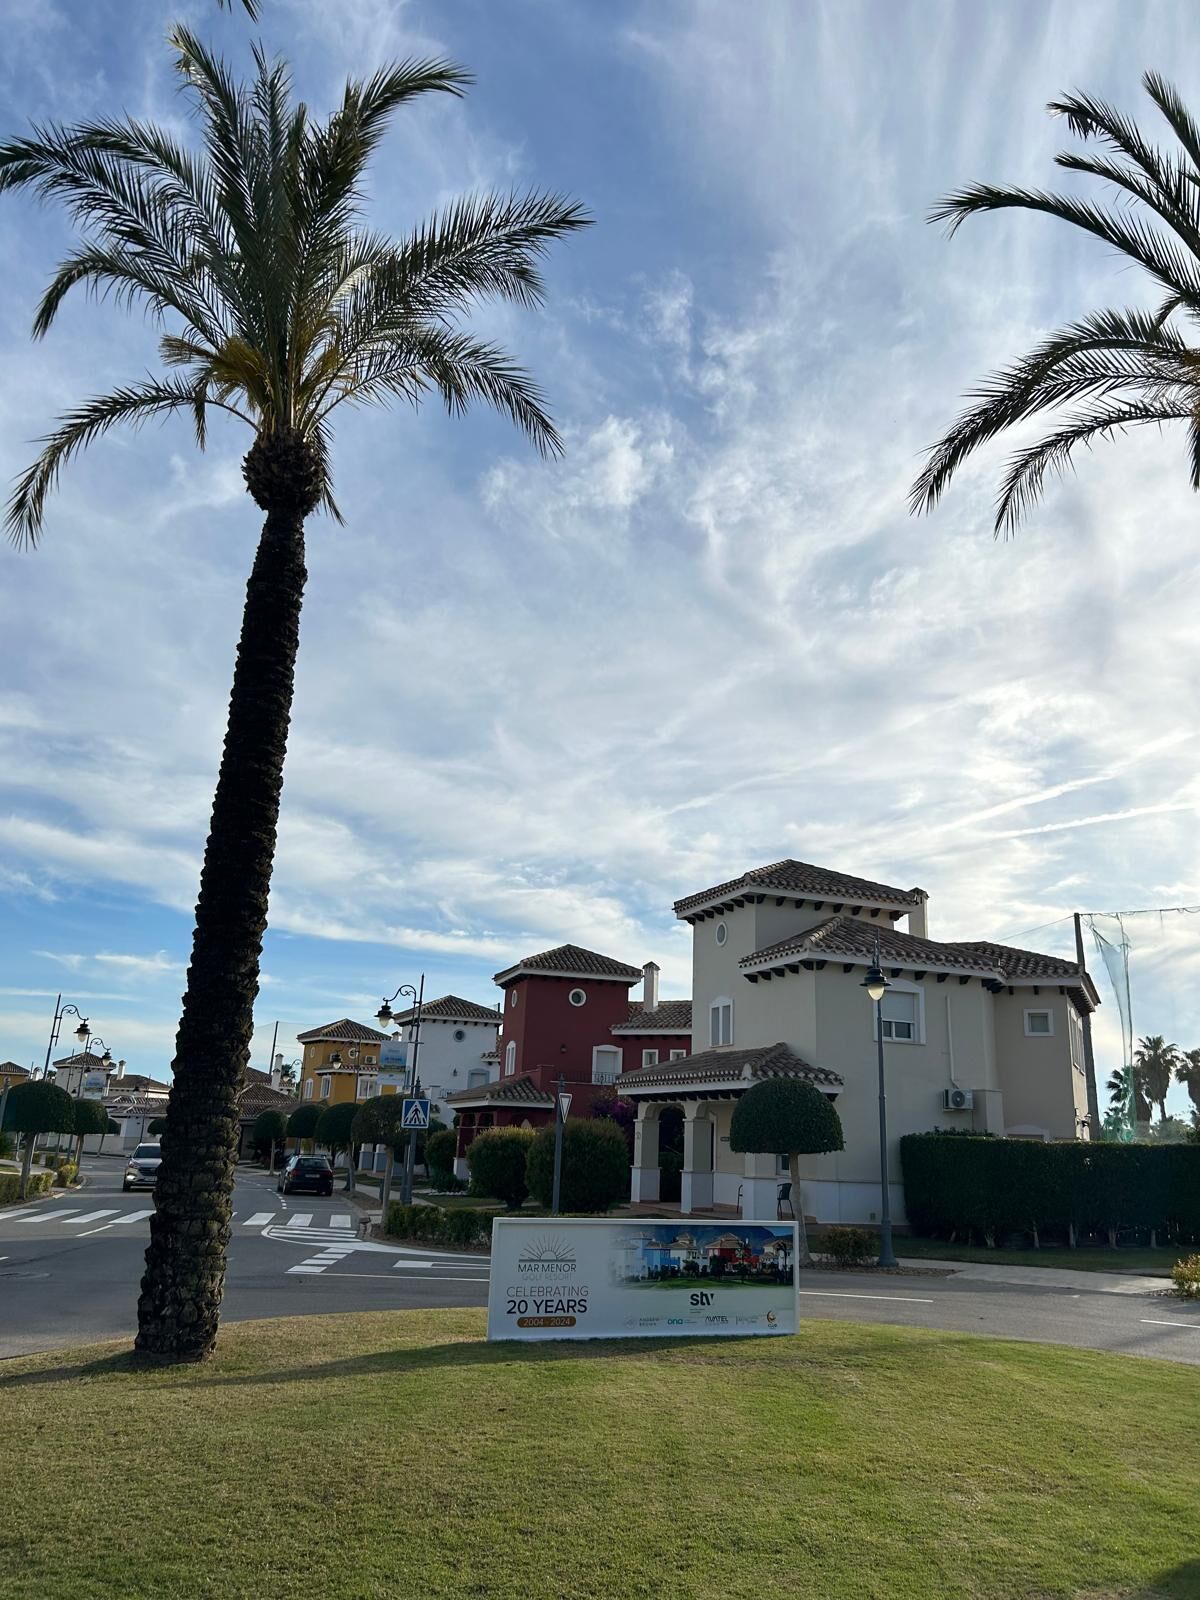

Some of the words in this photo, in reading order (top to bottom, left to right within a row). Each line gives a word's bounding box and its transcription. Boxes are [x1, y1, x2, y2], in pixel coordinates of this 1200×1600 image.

[518, 1263, 540, 1273] MAR
[541, 1263, 577, 1273] MENOR
[506, 1286, 589, 1298] CELEBRATING
[506, 1299, 528, 1314] 20
[533, 1299, 588, 1314] YEARS
[523, 1318, 544, 1326] 2004
[550, 1317, 570, 1326] 2024
